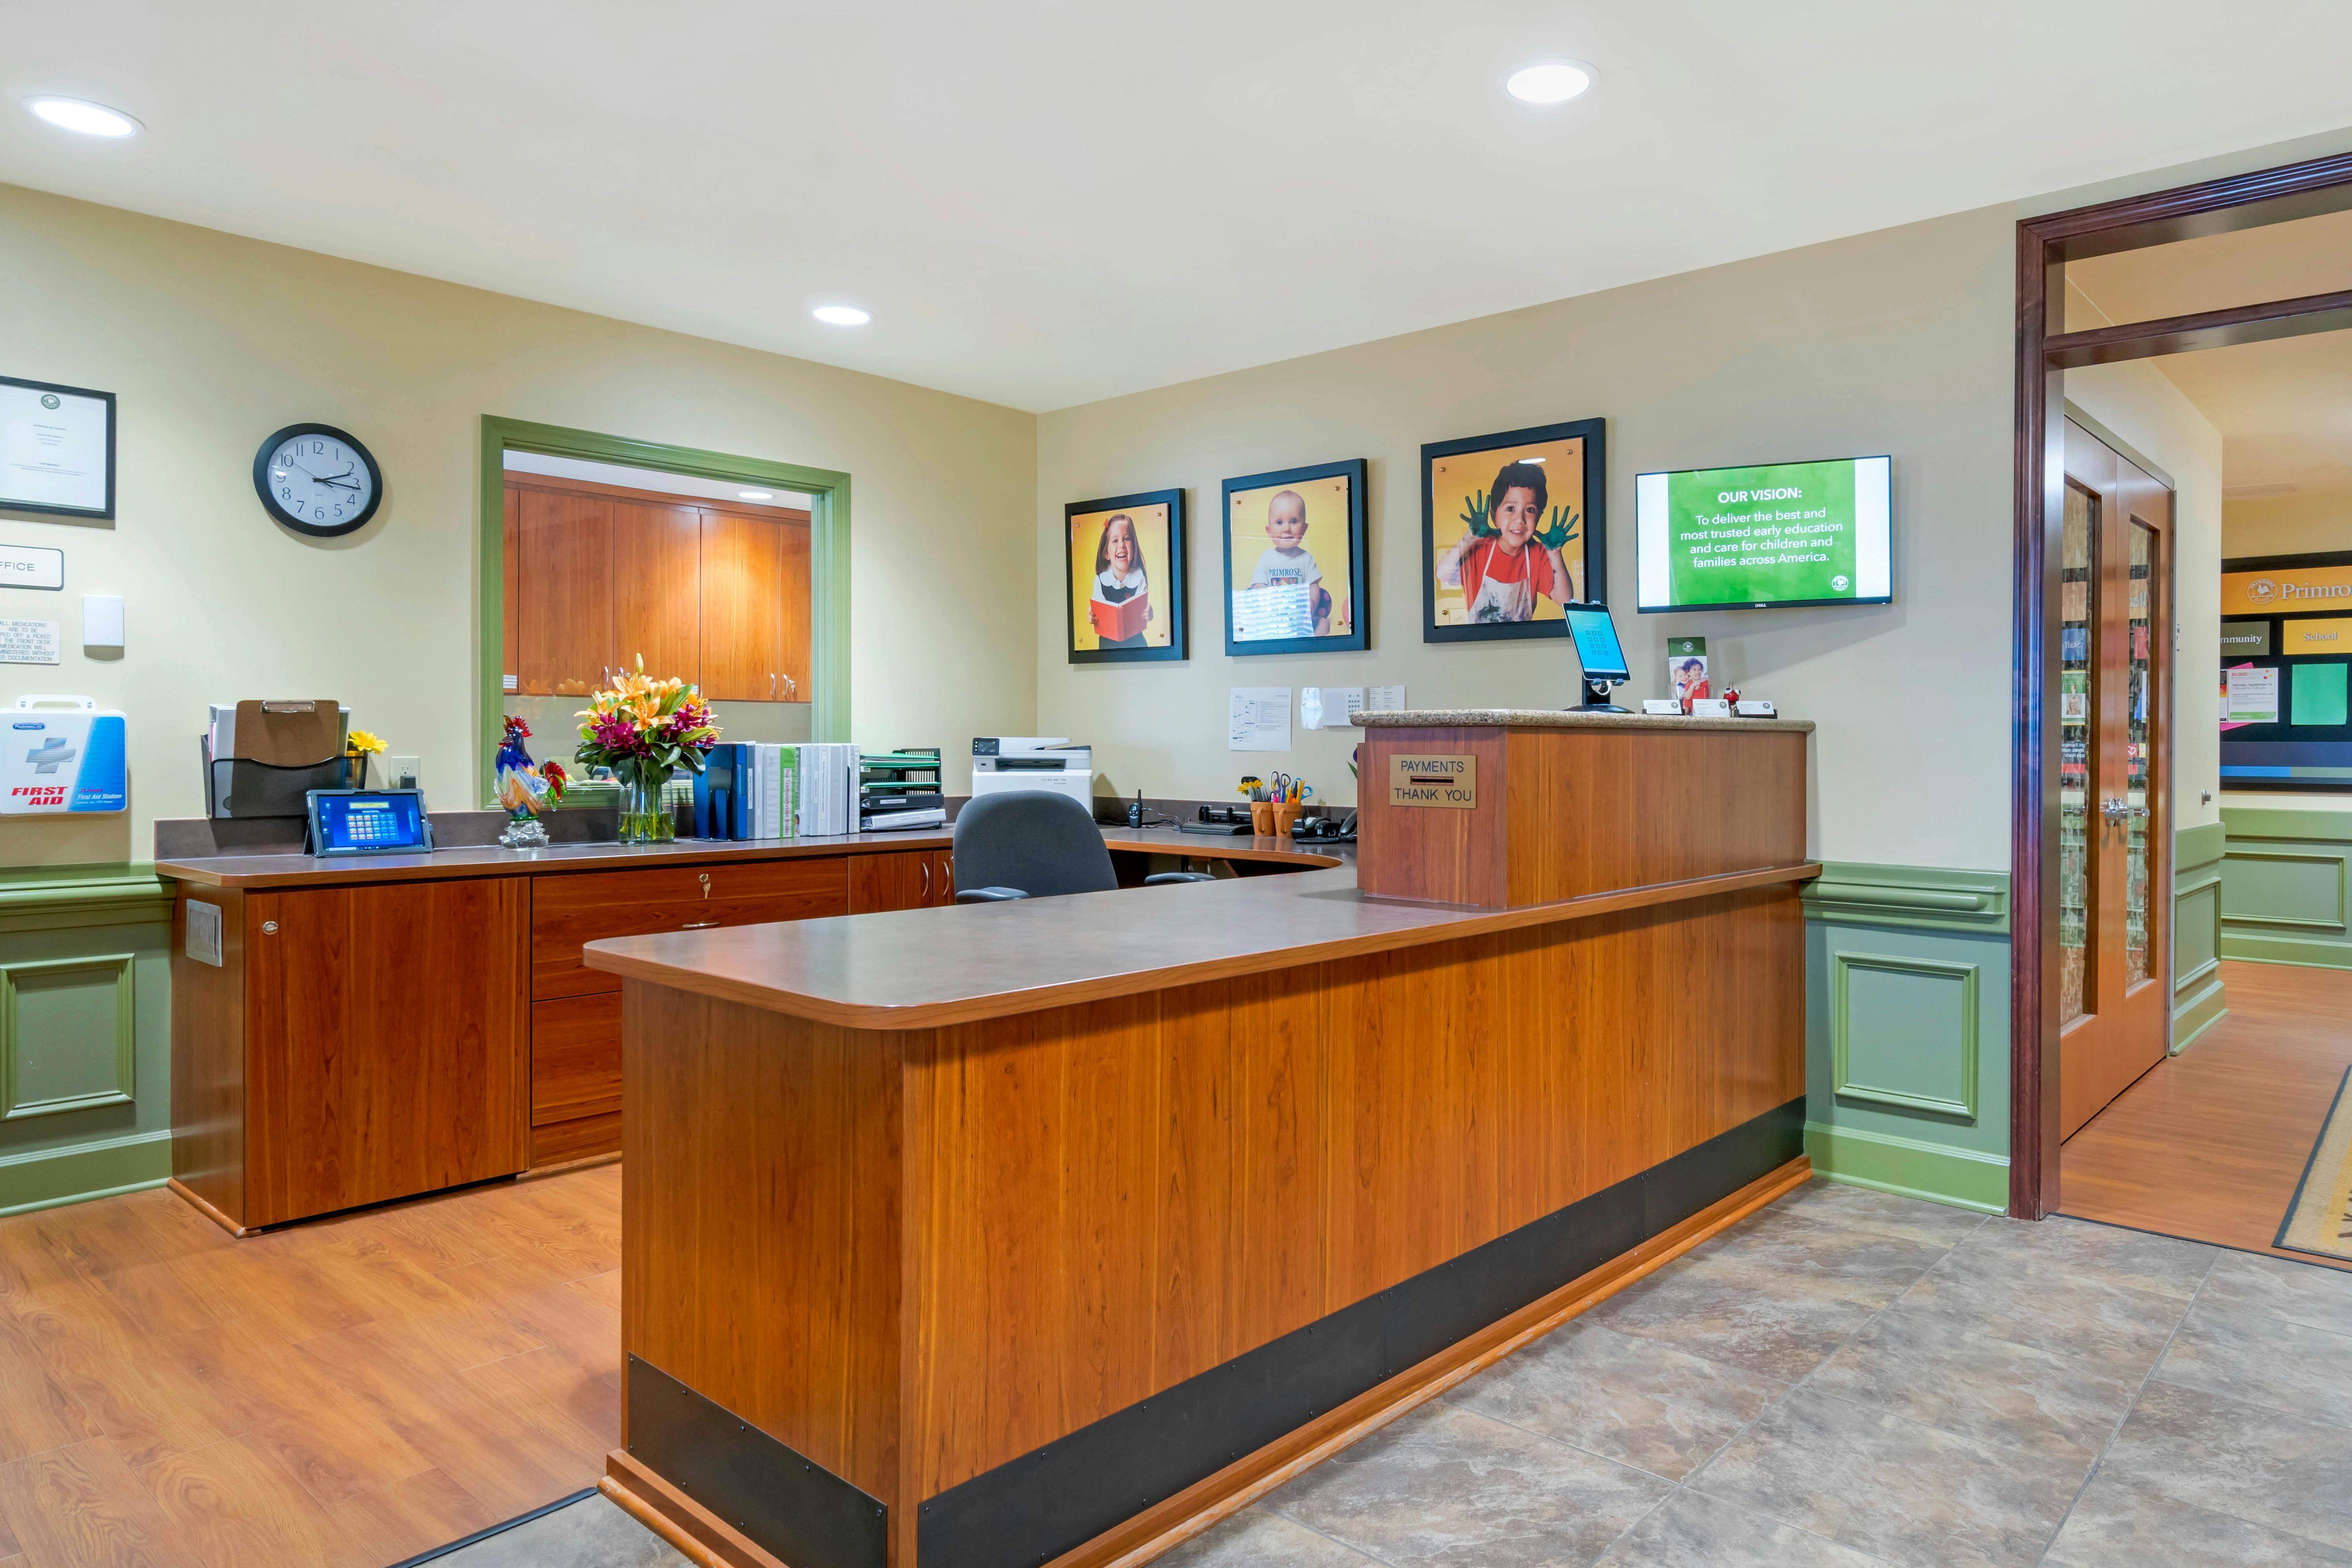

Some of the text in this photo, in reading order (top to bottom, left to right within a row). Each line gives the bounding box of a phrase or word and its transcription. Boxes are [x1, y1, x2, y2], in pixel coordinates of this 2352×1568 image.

[296, 444, 303, 456] 11
[313, 441, 324, 454] 12
[281, 454, 294, 467] 10
[336, 448, 338, 461] 1
[347, 461, 355, 474] 2
[352, 478, 360, 491] 3
[282, 487, 291, 500] 8
[347, 494, 356, 506] 4
[1718, 487, 1802, 503] OUR VISION:
[296, 500, 305, 513] 7
[315, 507, 324, 519] 6
[334, 504, 342, 517] 5
[1695, 507, 1826, 526] To deliver the best and
[1681, 523, 1843, 541] most trusted early education
[1690, 535, 1833, 554] and care for children and
[1693, 553, 1829, 568] families across America.
[2281, 583, 2352, 599] Primro
[2220, 634, 2262, 644] mmunity
[2304, 632, 2337, 641] School
[1401, 760, 1464, 773] PAYMENTS
[11, 786, 68, 796] FIRST
[1394, 788, 1472, 801] THANK YOU
[28, 797, 64, 805] AID
